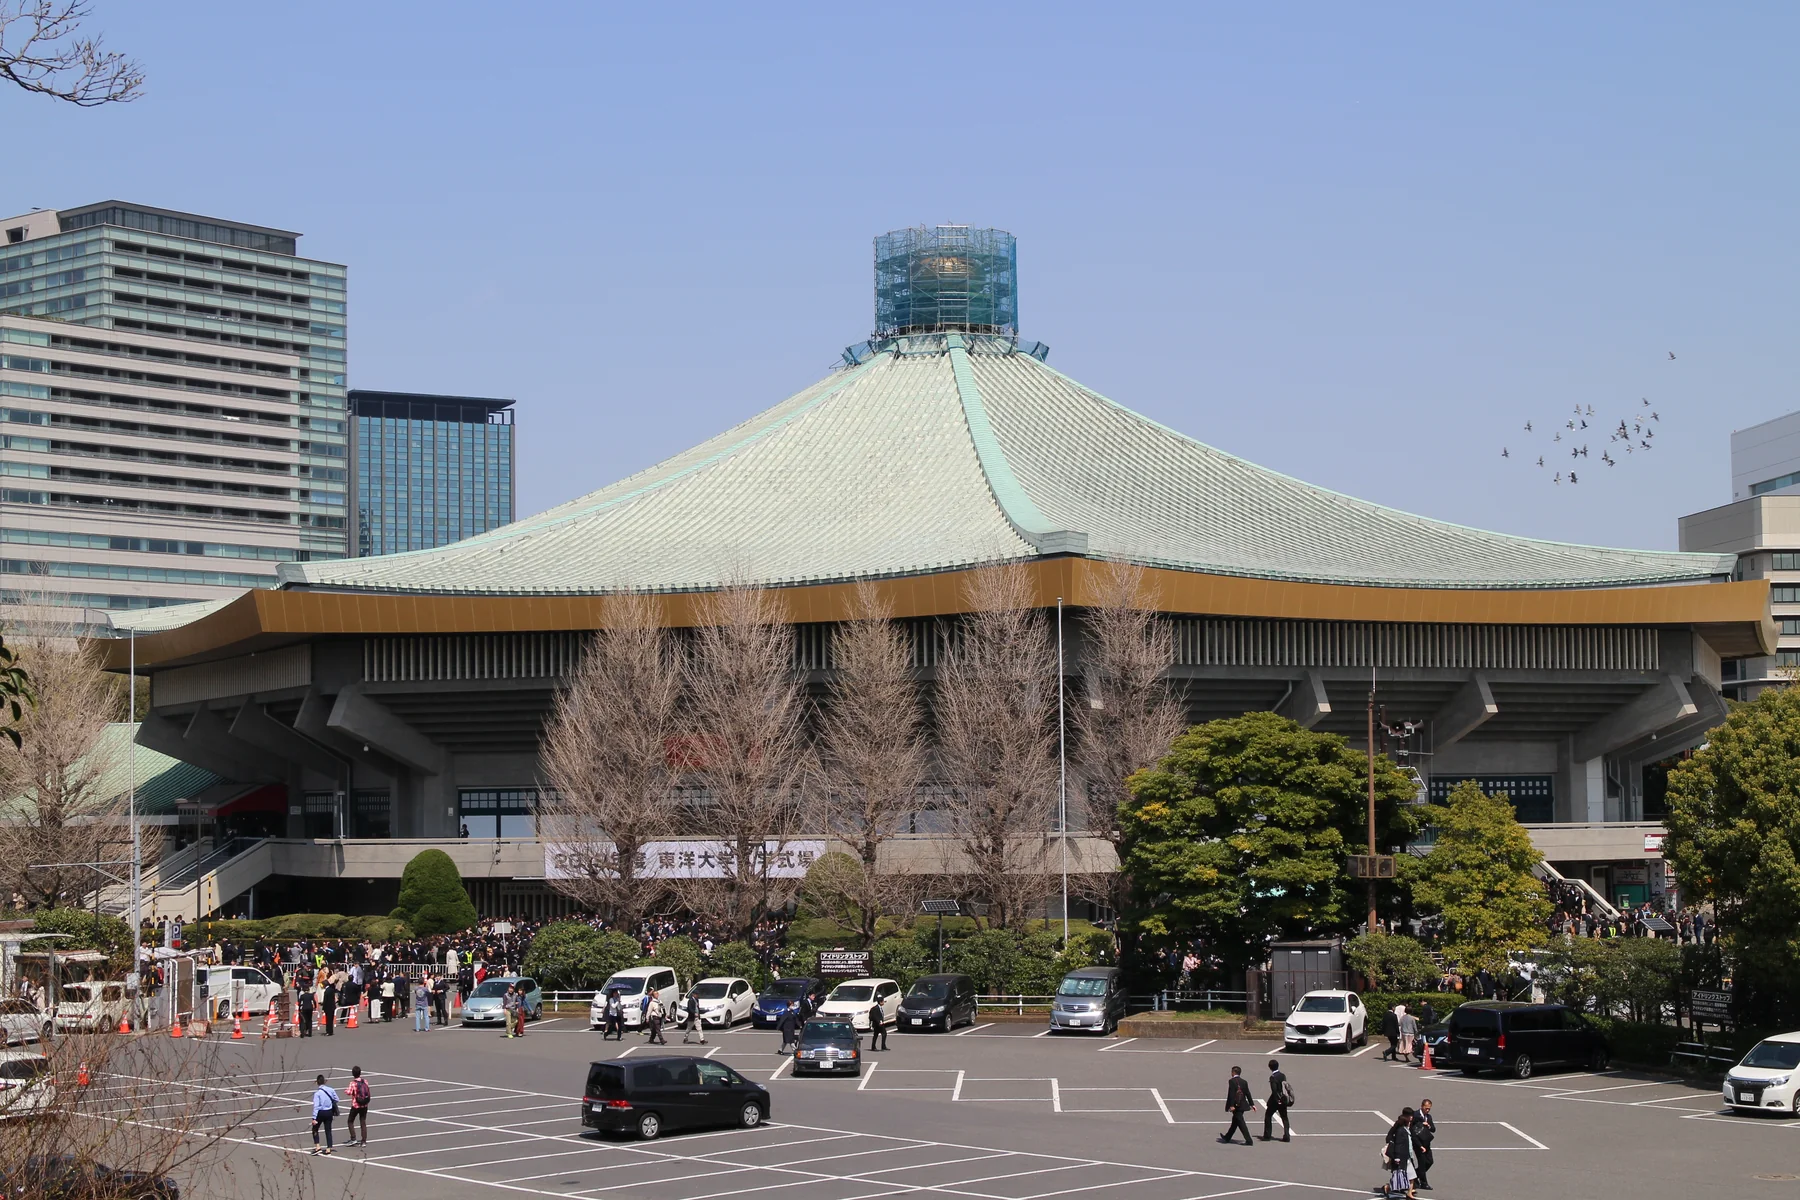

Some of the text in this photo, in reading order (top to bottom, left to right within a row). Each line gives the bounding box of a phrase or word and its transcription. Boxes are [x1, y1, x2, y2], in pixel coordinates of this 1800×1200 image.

[658, 850, 814, 869] 東洋大学学式場
